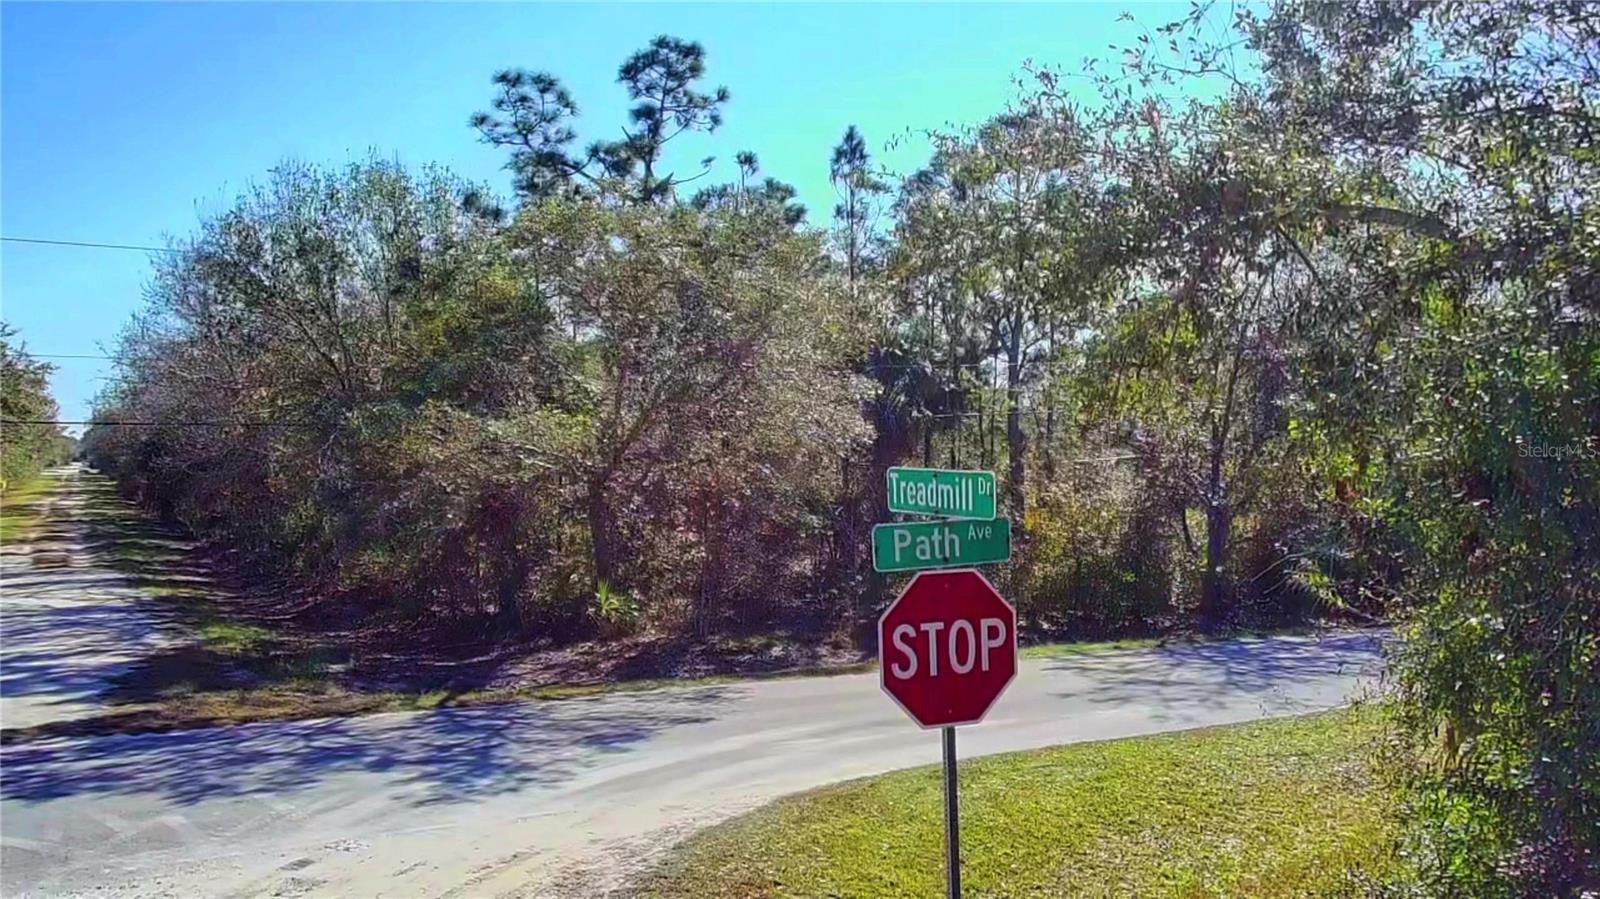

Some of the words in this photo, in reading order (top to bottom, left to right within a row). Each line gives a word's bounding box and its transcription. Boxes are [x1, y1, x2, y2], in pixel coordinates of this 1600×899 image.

[890, 473, 973, 511] Treadmill
[978, 477, 991, 495] Dr
[893, 527, 960, 563] Path
[968, 523, 992, 540] Ave
[891, 618, 1006, 680] STOP
